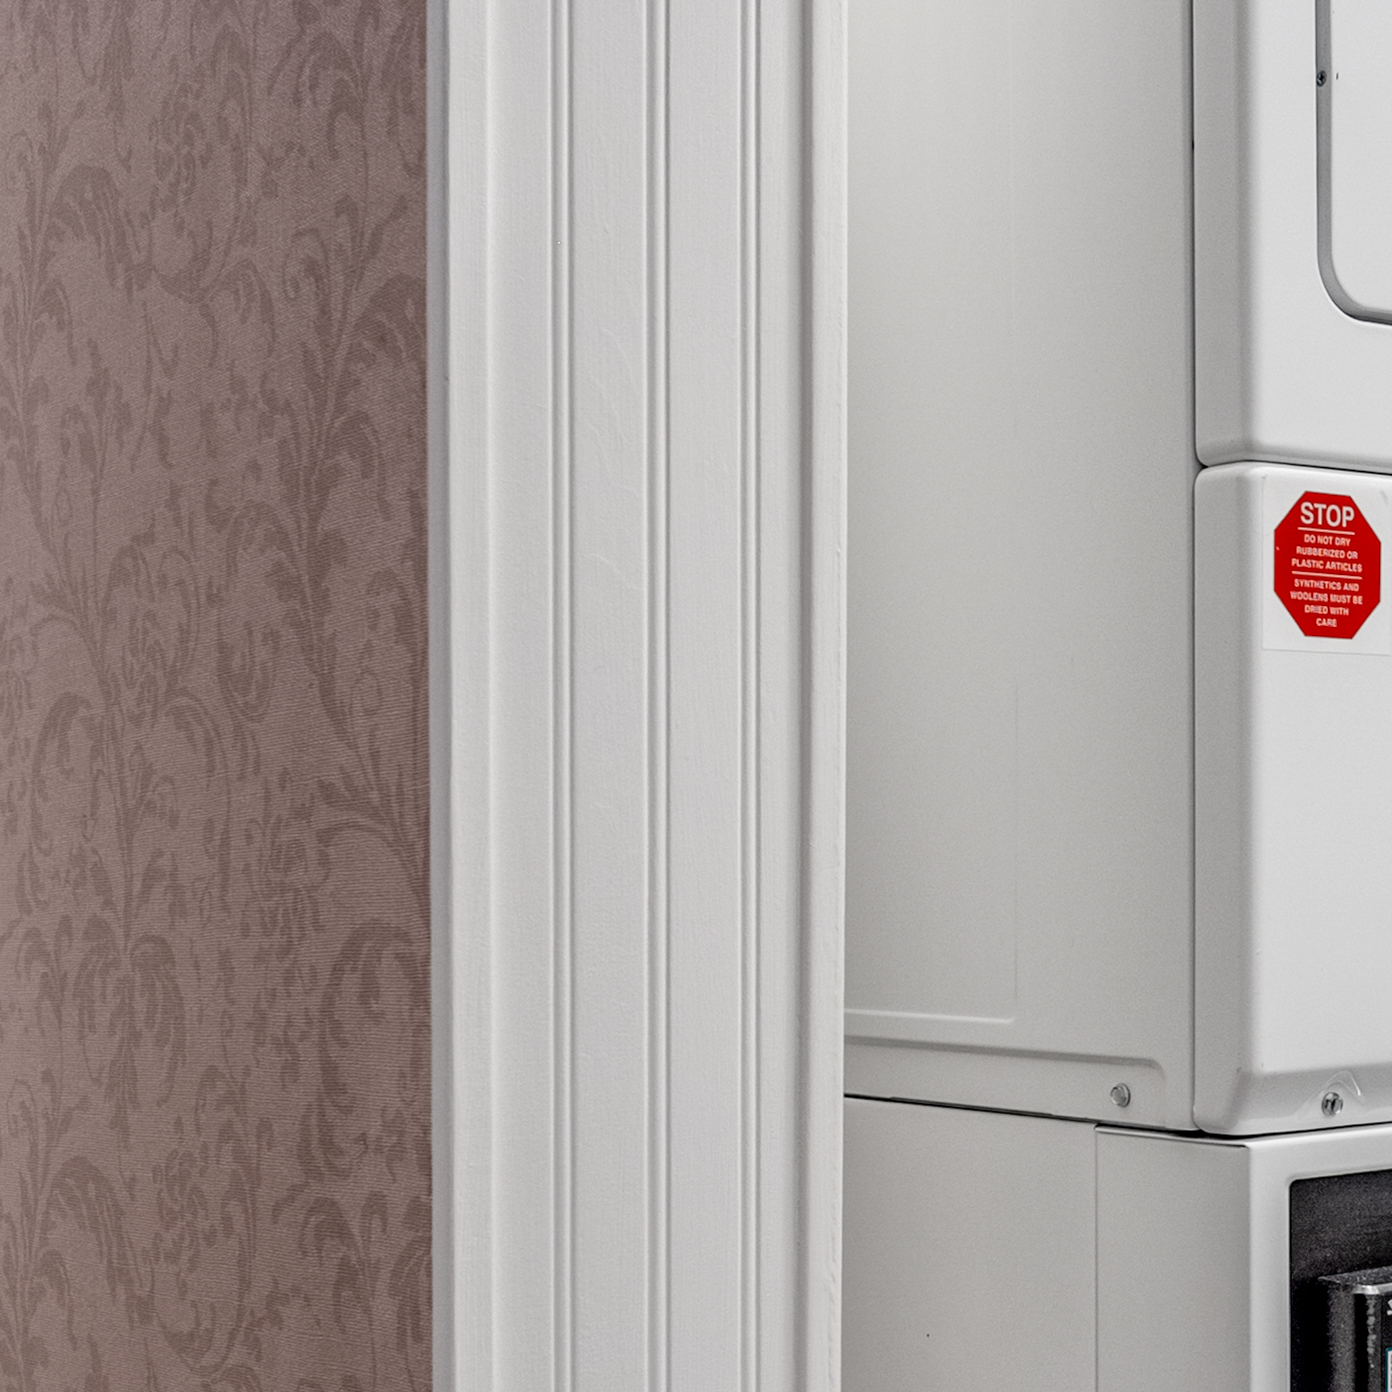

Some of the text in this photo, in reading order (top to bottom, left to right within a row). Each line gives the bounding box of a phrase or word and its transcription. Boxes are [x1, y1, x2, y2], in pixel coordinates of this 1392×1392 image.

[1300, 501, 1355, 527] STOP
[1304, 534, 1351, 546] DO NOT DRY
[1296, 546, 1358, 559] RUBBERIZED OR
[1291, 558, 1362, 572] PLASTIC ARTICLES
[1294, 579, 1359, 592] SYNTHETICS AND
[1290, 591, 1363, 605] WOOLENS MUST BE
[1304, 604, 1349, 616] DRIED WITH
[1316, 618, 1337, 627] CARE
